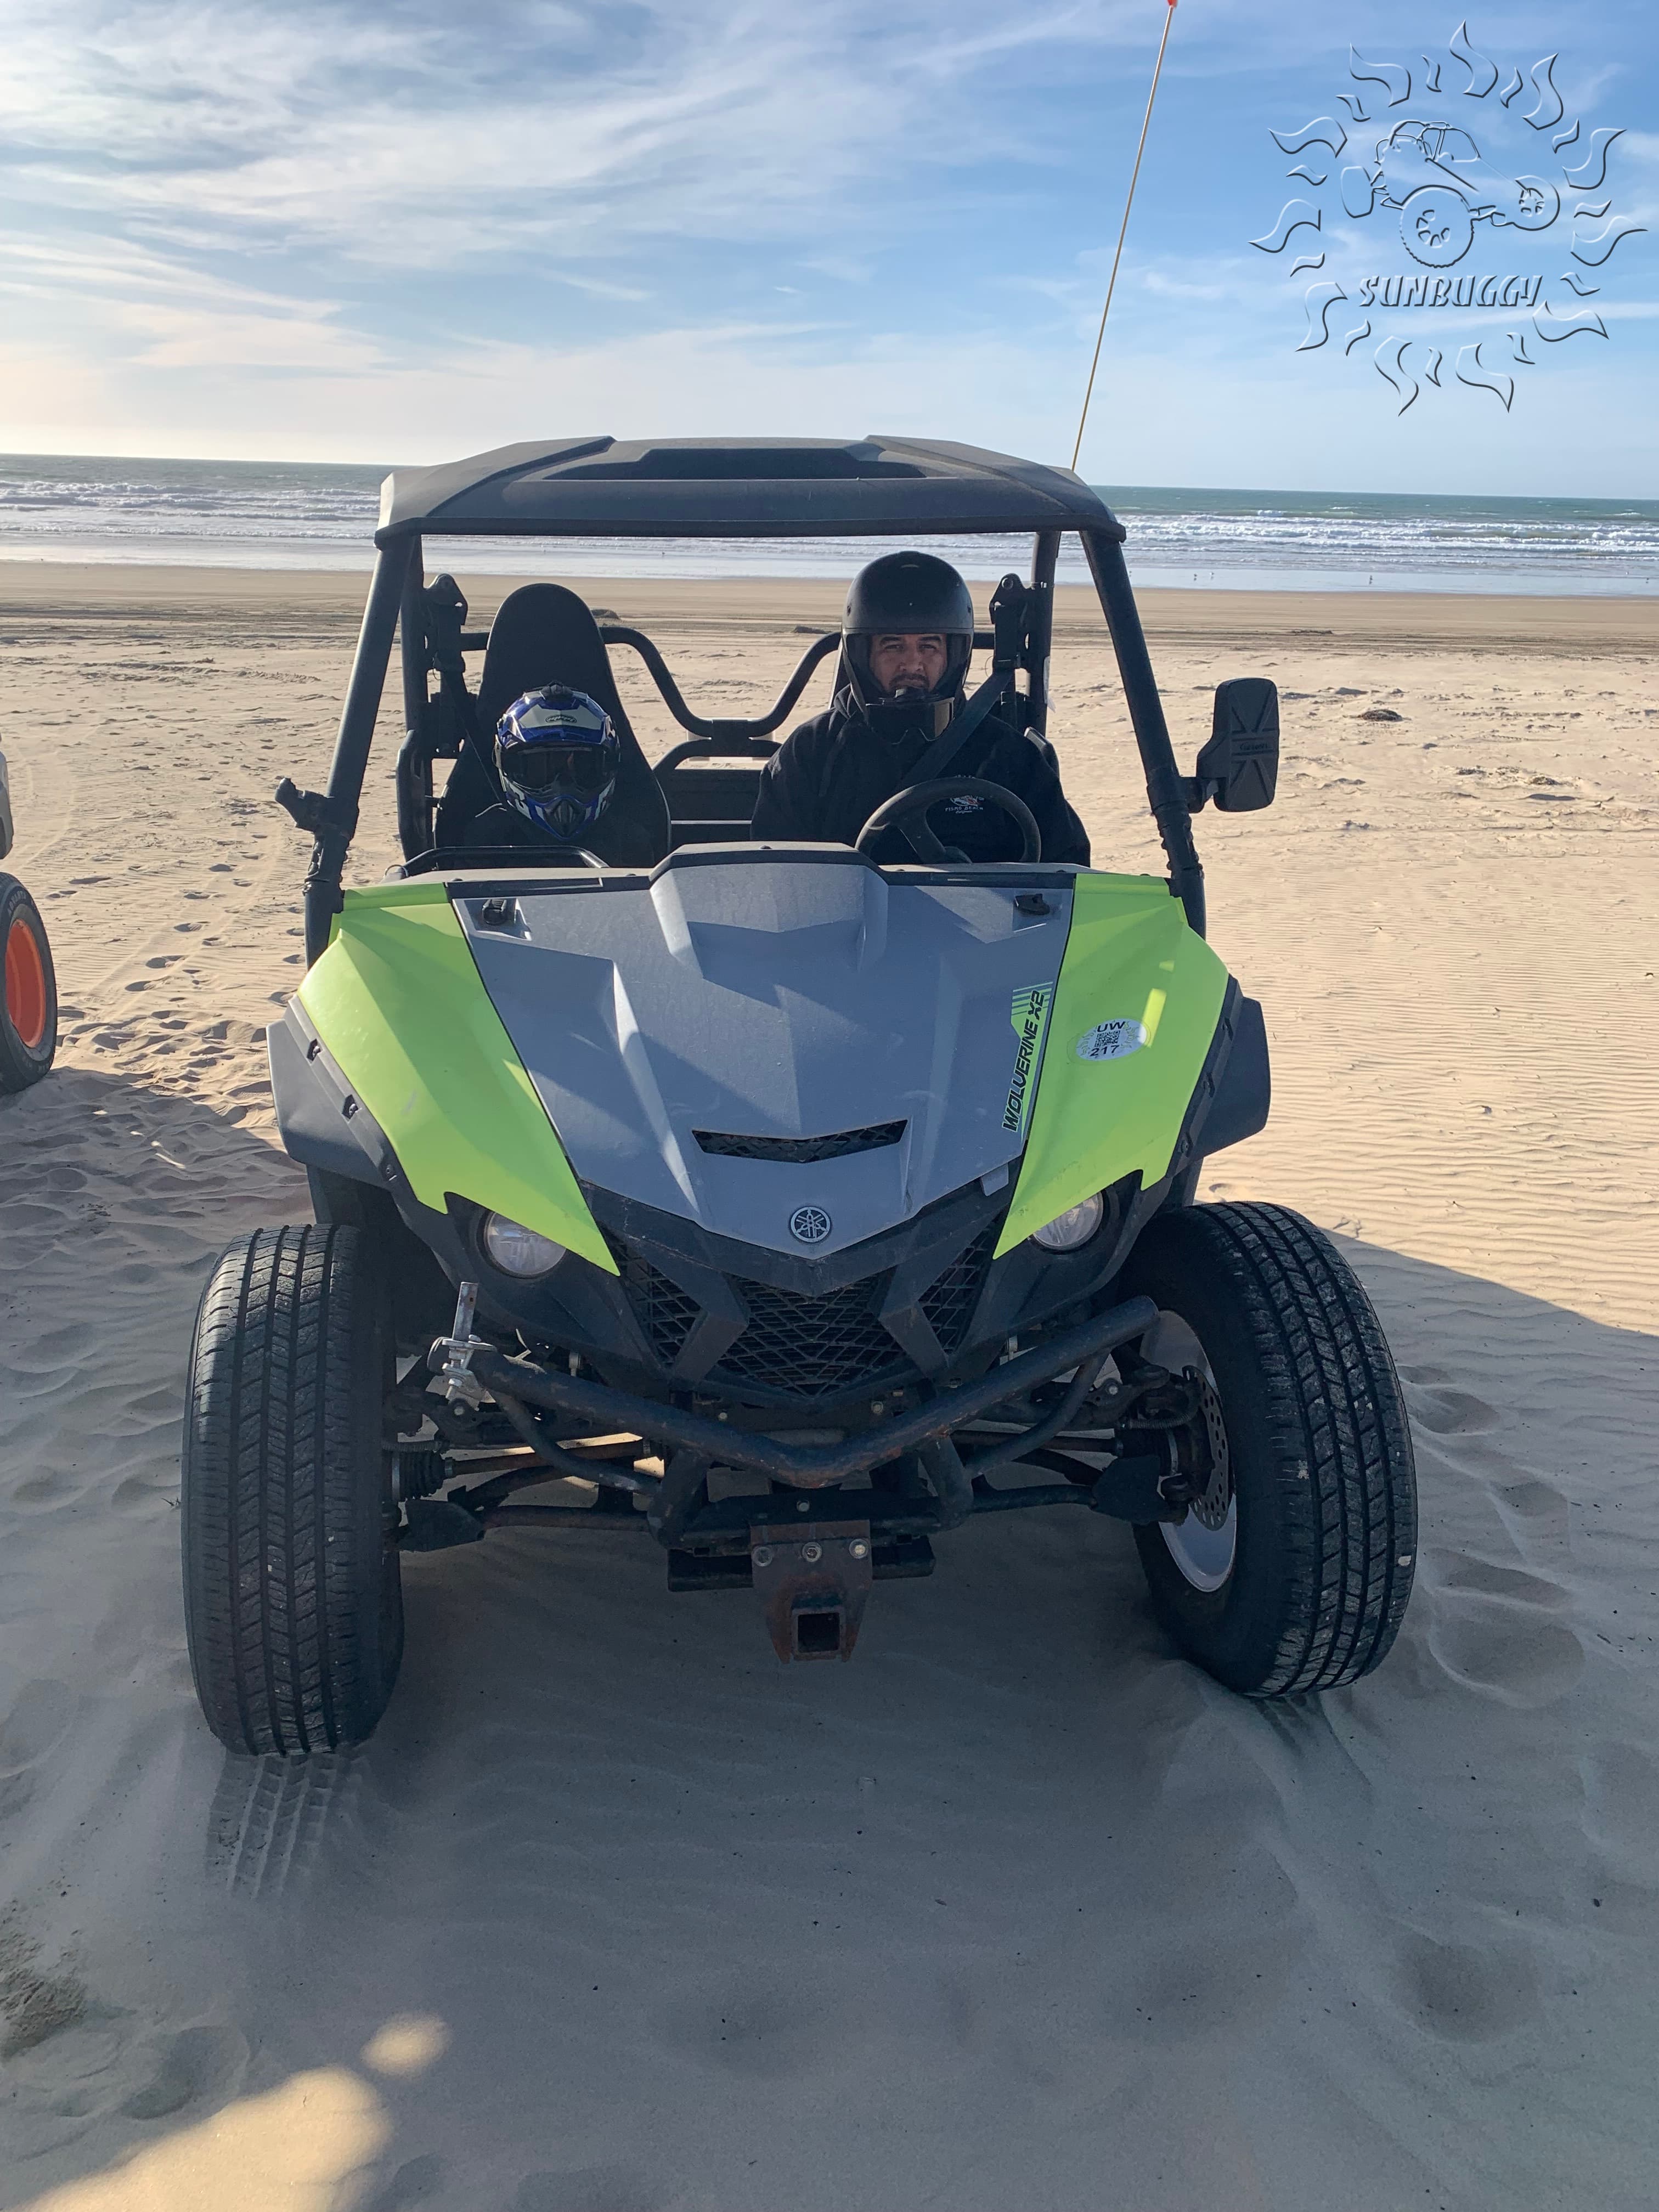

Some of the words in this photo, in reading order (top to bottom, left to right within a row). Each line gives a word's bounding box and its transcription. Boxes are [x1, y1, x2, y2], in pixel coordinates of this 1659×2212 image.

[1097, 1021, 1126, 1032] UW
[1089, 1045, 1120, 1057] 217
[1002, 1018, 1039, 1132] WOLVERINE
[1028, 990, 1045, 1020] X2
